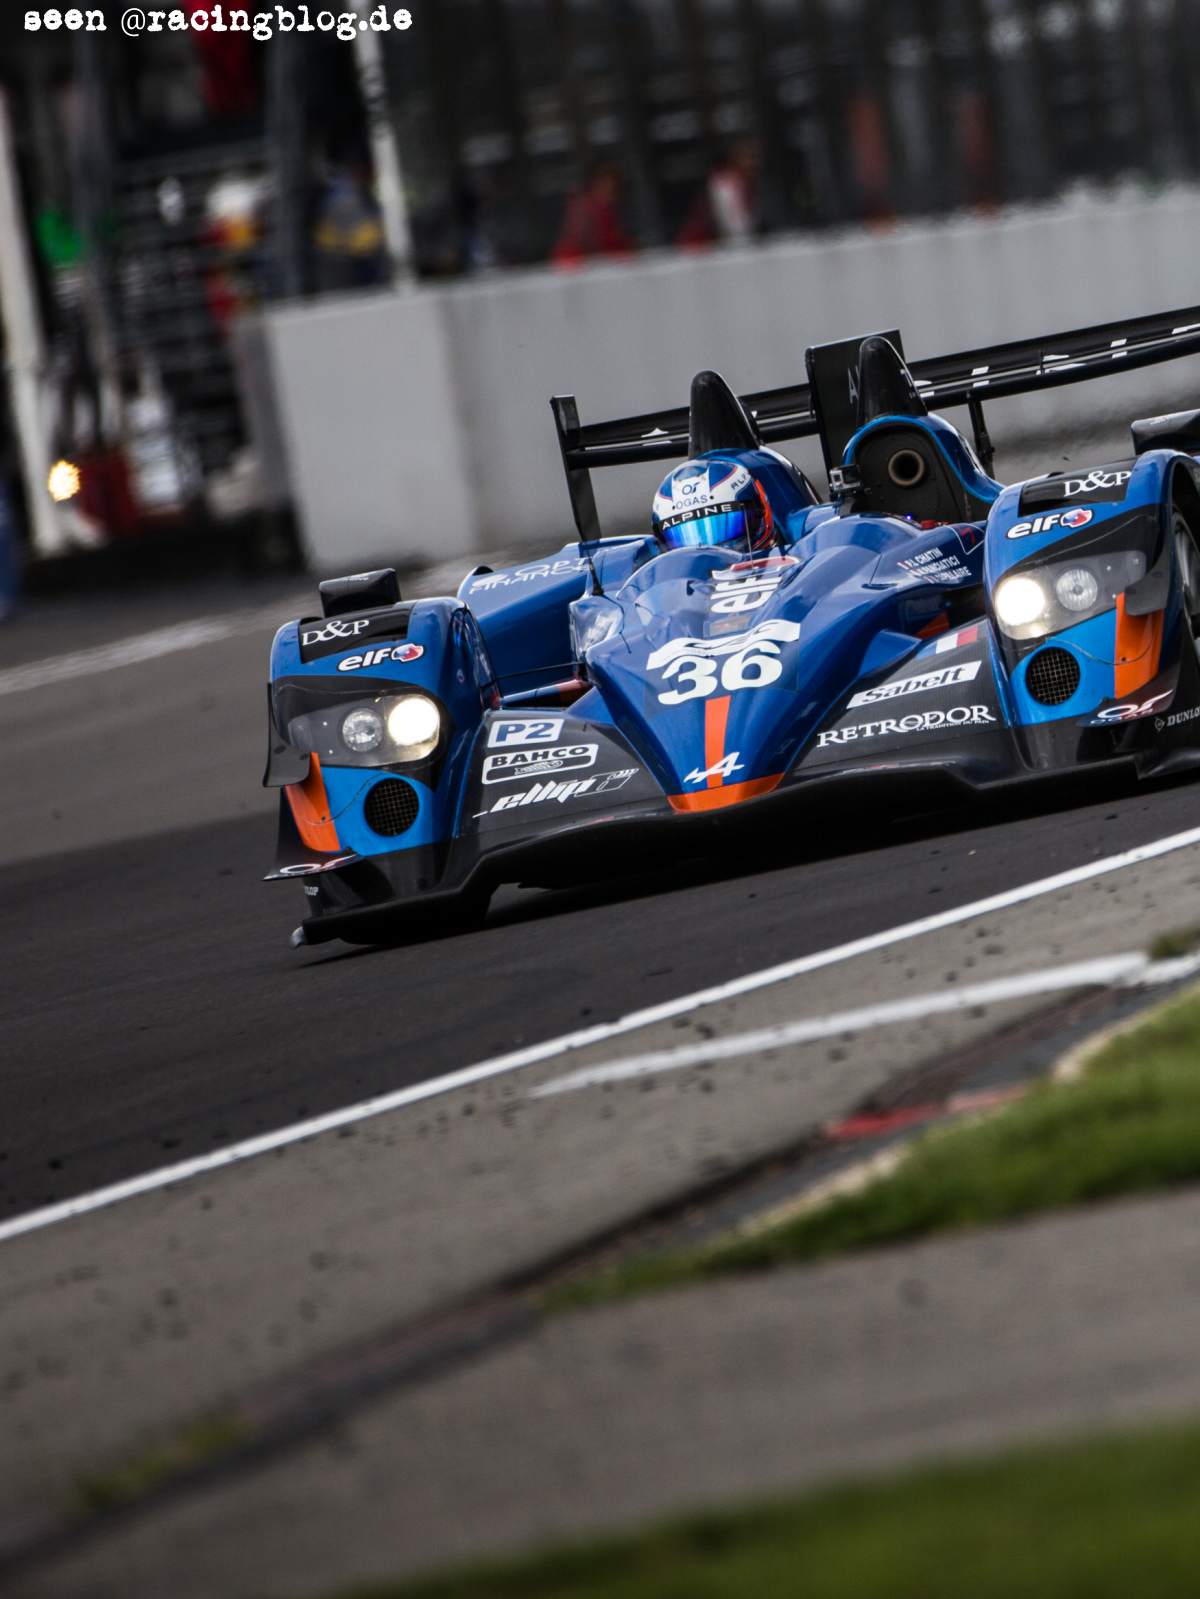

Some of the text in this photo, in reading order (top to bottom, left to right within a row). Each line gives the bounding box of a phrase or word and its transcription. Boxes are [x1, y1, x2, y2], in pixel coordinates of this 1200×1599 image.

[1063, 471, 1132, 497] D&P
[661, 503, 733, 531] ALPINE
[302, 619, 369, 646] D&P
[658, 640, 783, 705] 36
[861, 666, 965, 703] Sabelt
[495, 722, 555, 742] P2
[816, 704, 997, 747] RETRODOR
[491, 746, 589, 767] BAHCO
